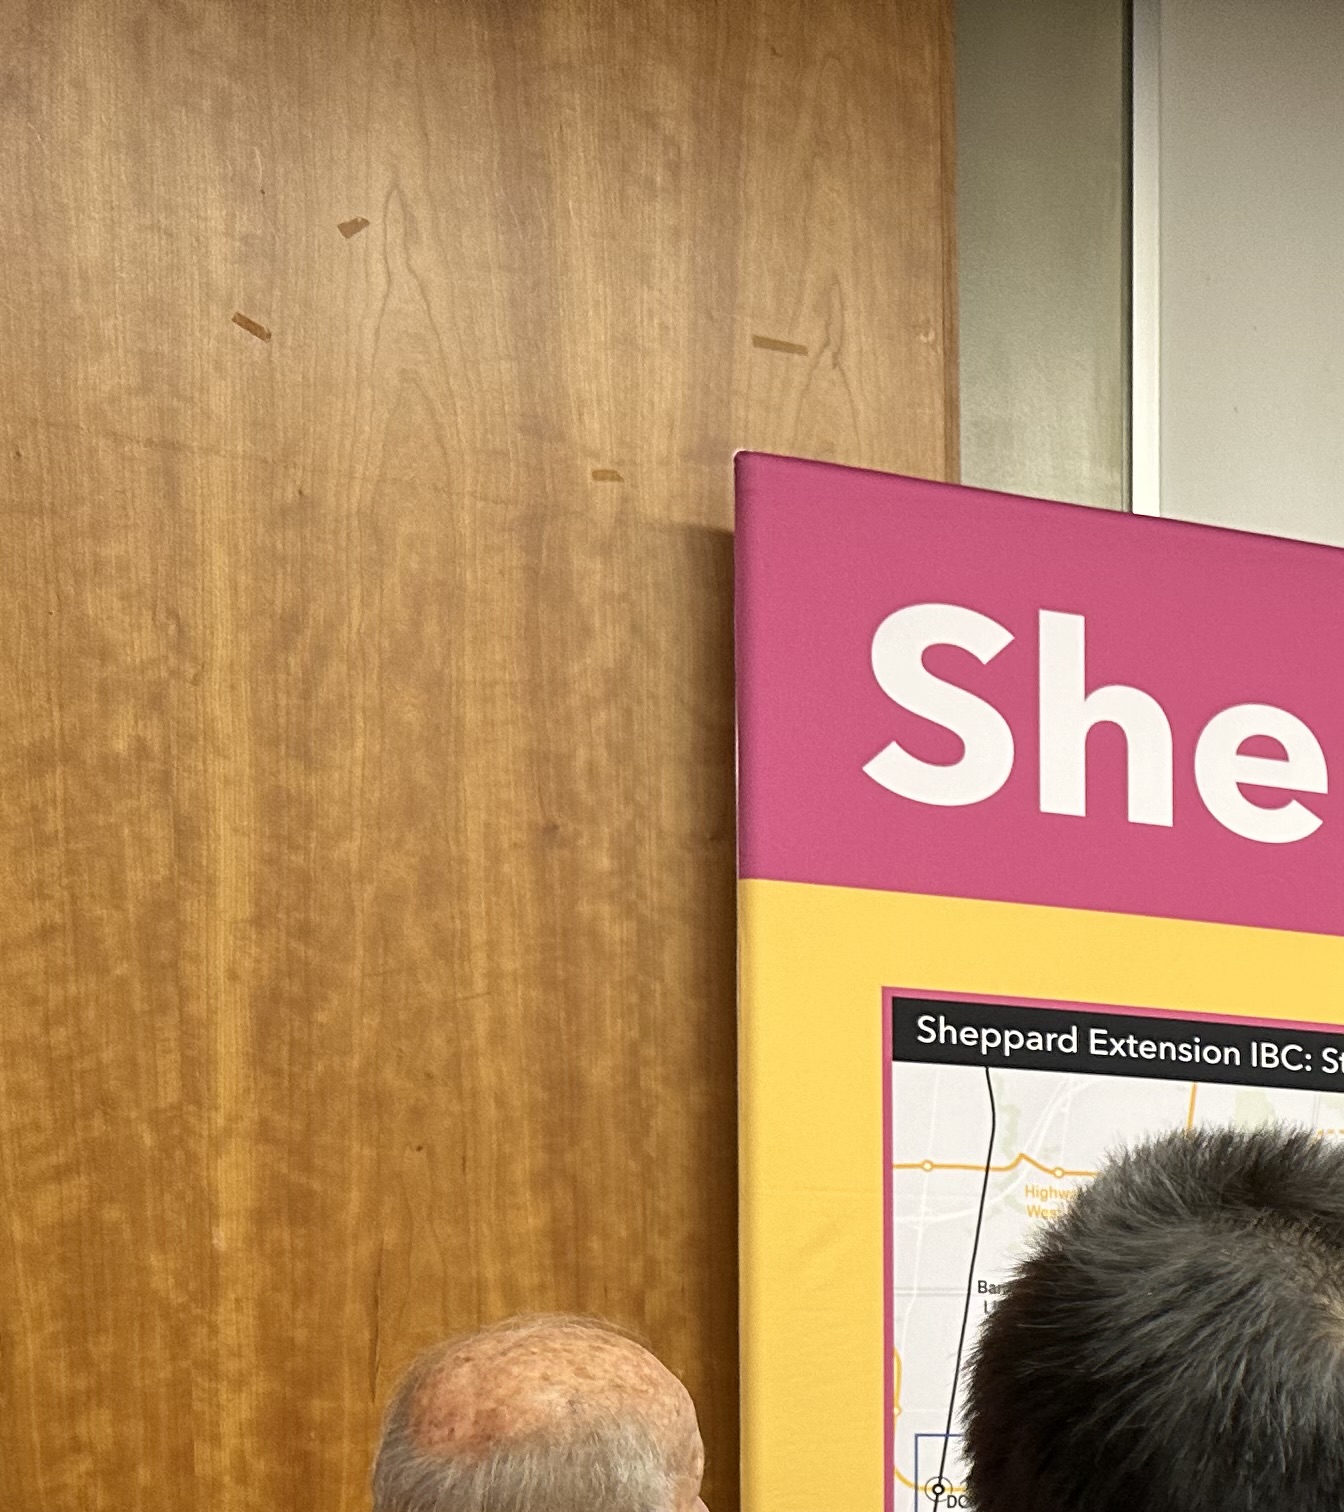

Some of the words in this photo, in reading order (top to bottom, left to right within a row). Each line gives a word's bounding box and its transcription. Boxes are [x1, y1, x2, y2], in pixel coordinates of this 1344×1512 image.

[917, 1015, 1078, 1057] Sheppard
[1089, 1028, 1241, 1066] Extension
[1251, 1041, 1312, 1072] IBC:
